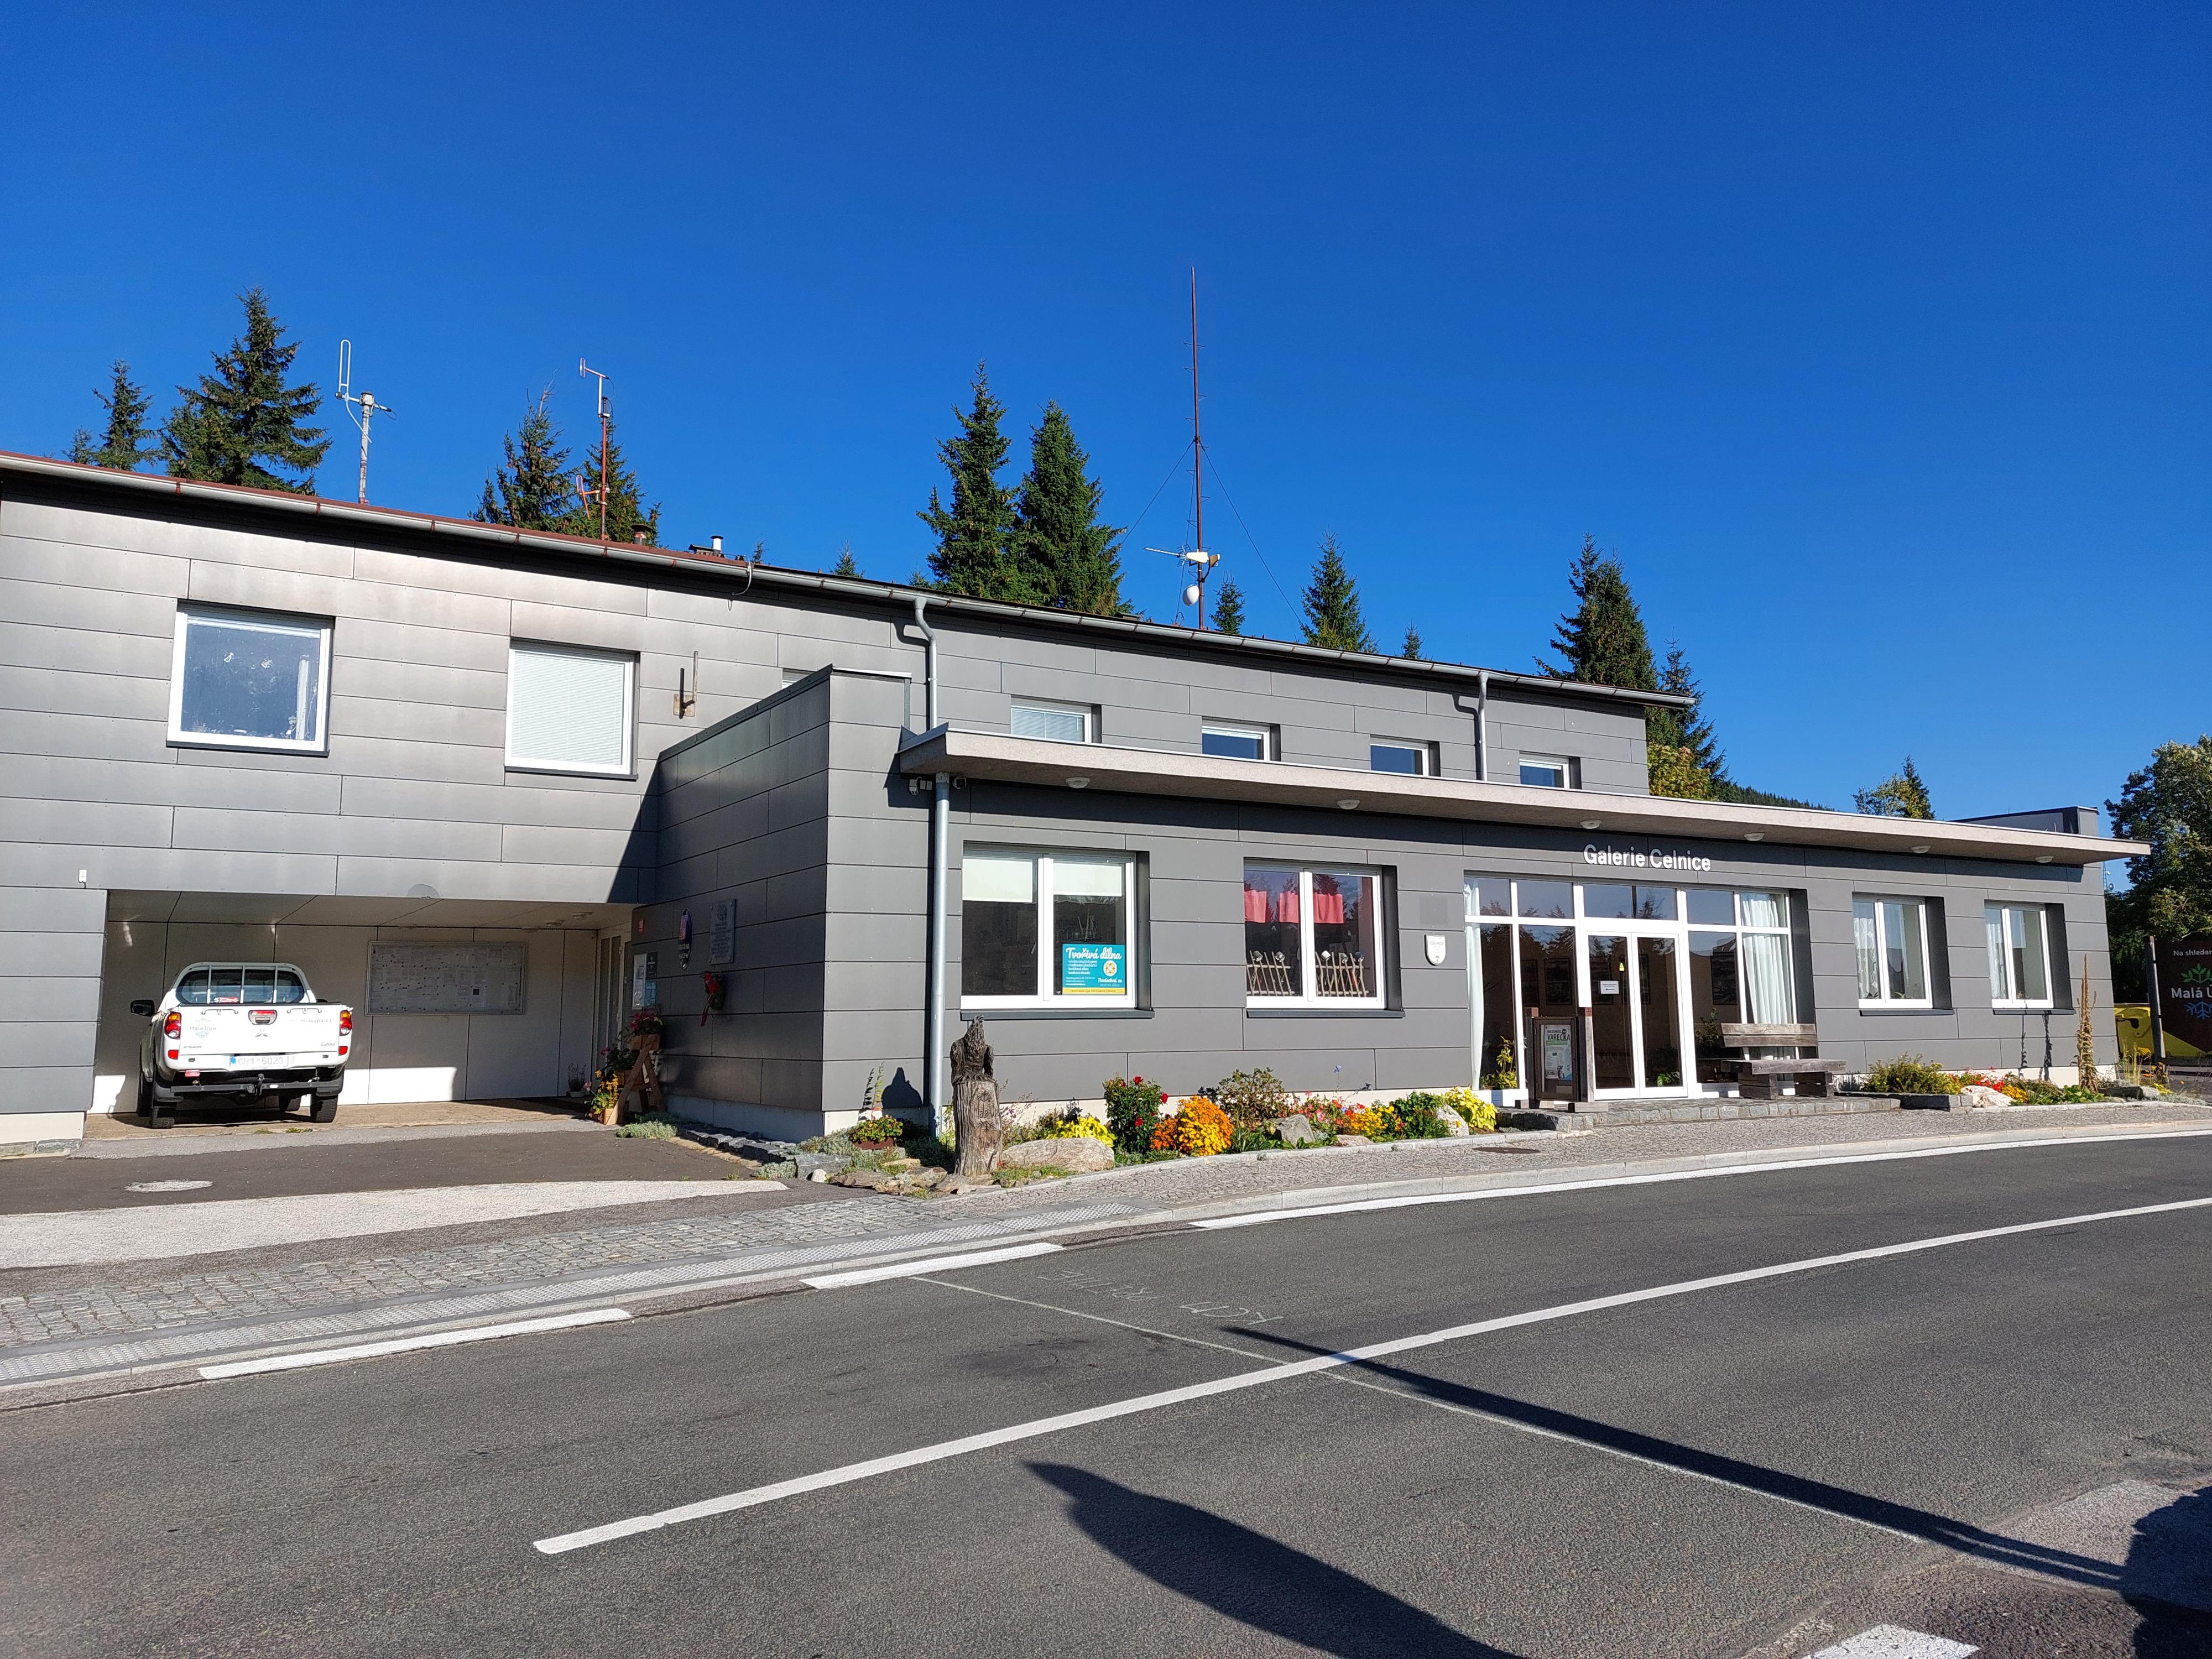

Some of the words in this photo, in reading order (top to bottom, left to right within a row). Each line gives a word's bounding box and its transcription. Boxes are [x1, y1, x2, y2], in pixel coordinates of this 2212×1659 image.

[1583, 844, 1645, 867] Galerie
[1649, 848, 1711, 872] Celnice
[1065, 947, 1099, 959] Tvořivá
[1099, 947, 1122, 959] dílna
[2171, 987, 2203, 999] Malá
